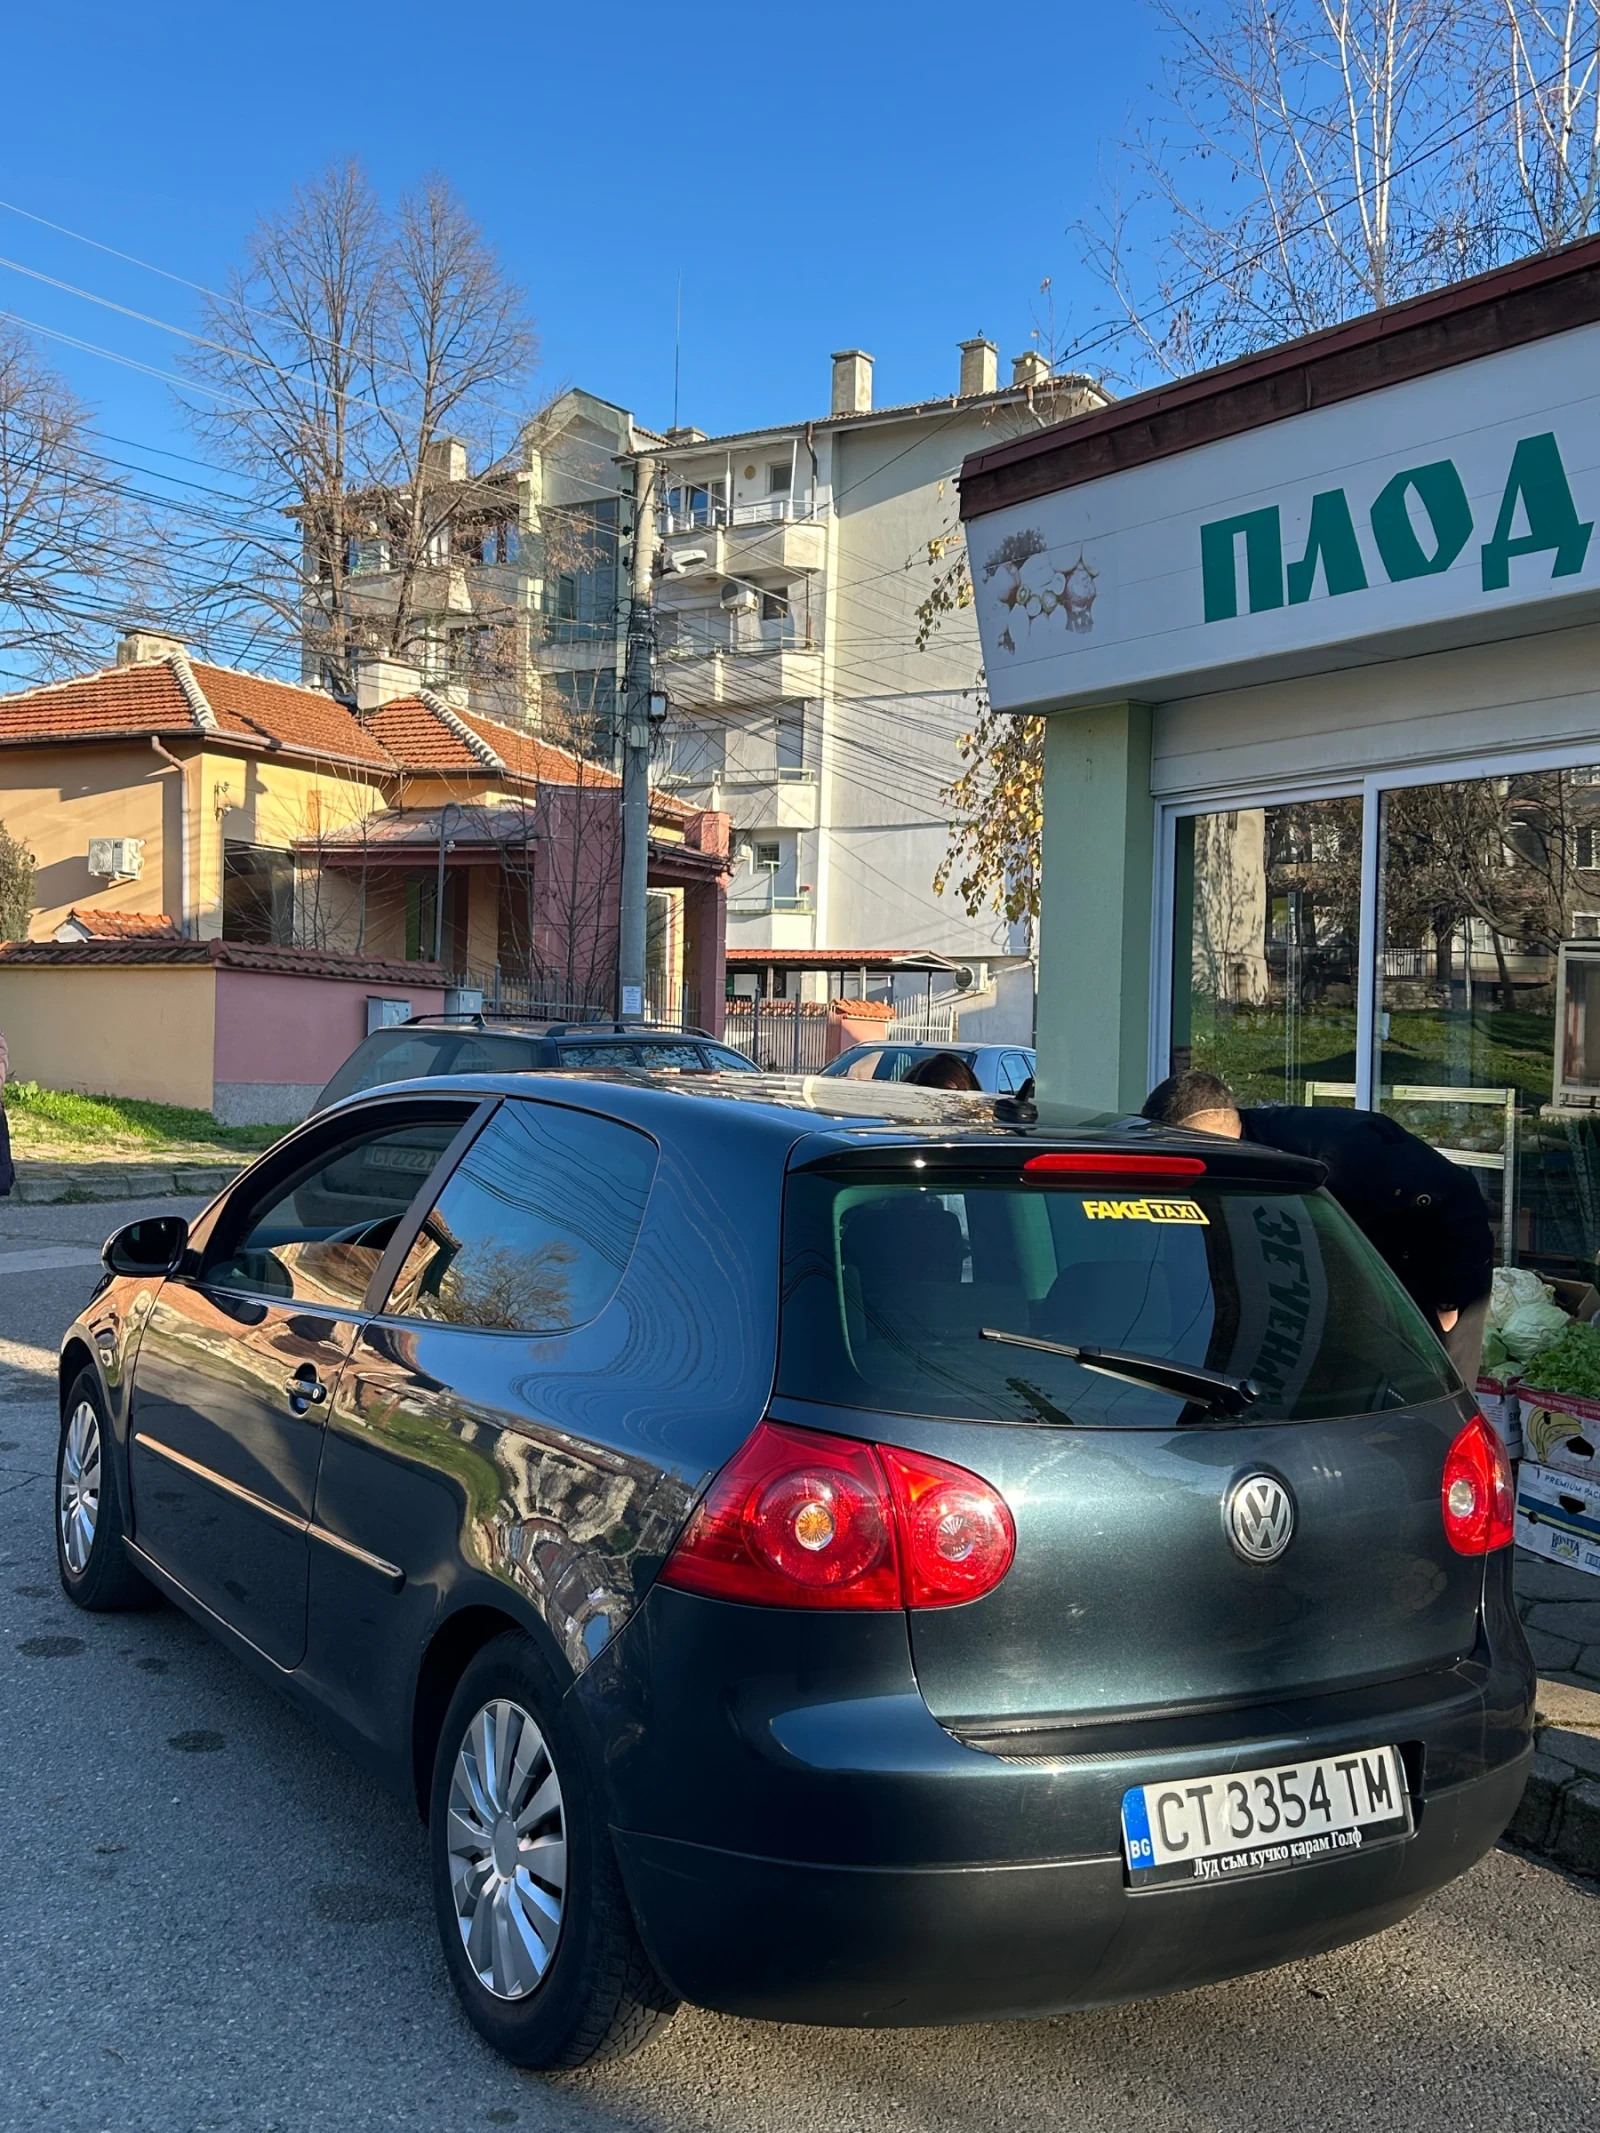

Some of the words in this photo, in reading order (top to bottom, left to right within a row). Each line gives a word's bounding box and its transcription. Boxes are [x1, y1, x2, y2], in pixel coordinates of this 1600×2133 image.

[1200, 431, 1595, 623] ПЛОД
[1082, 1200, 1151, 1220] FAKE
[1149, 1204, 1199, 1219] TAXI
[1545, 1474, 1582, 1493] PREMIUM
[1551, 1532, 1580, 1557] BONITA
[1157, 1783, 1213, 1851] CT
[1227, 1766, 1332, 1839] 3354
[1335, 1754, 1394, 1817] TM
[1130, 1839, 1151, 1859] BG
[1193, 1858, 1221, 1880] Луд
[1221, 1854, 1248, 1871] съм
[1249, 1845, 1289, 1868] кучко
[1290, 1837, 1330, 1859] карам
[1330, 1827, 1362, 1849] Голф
